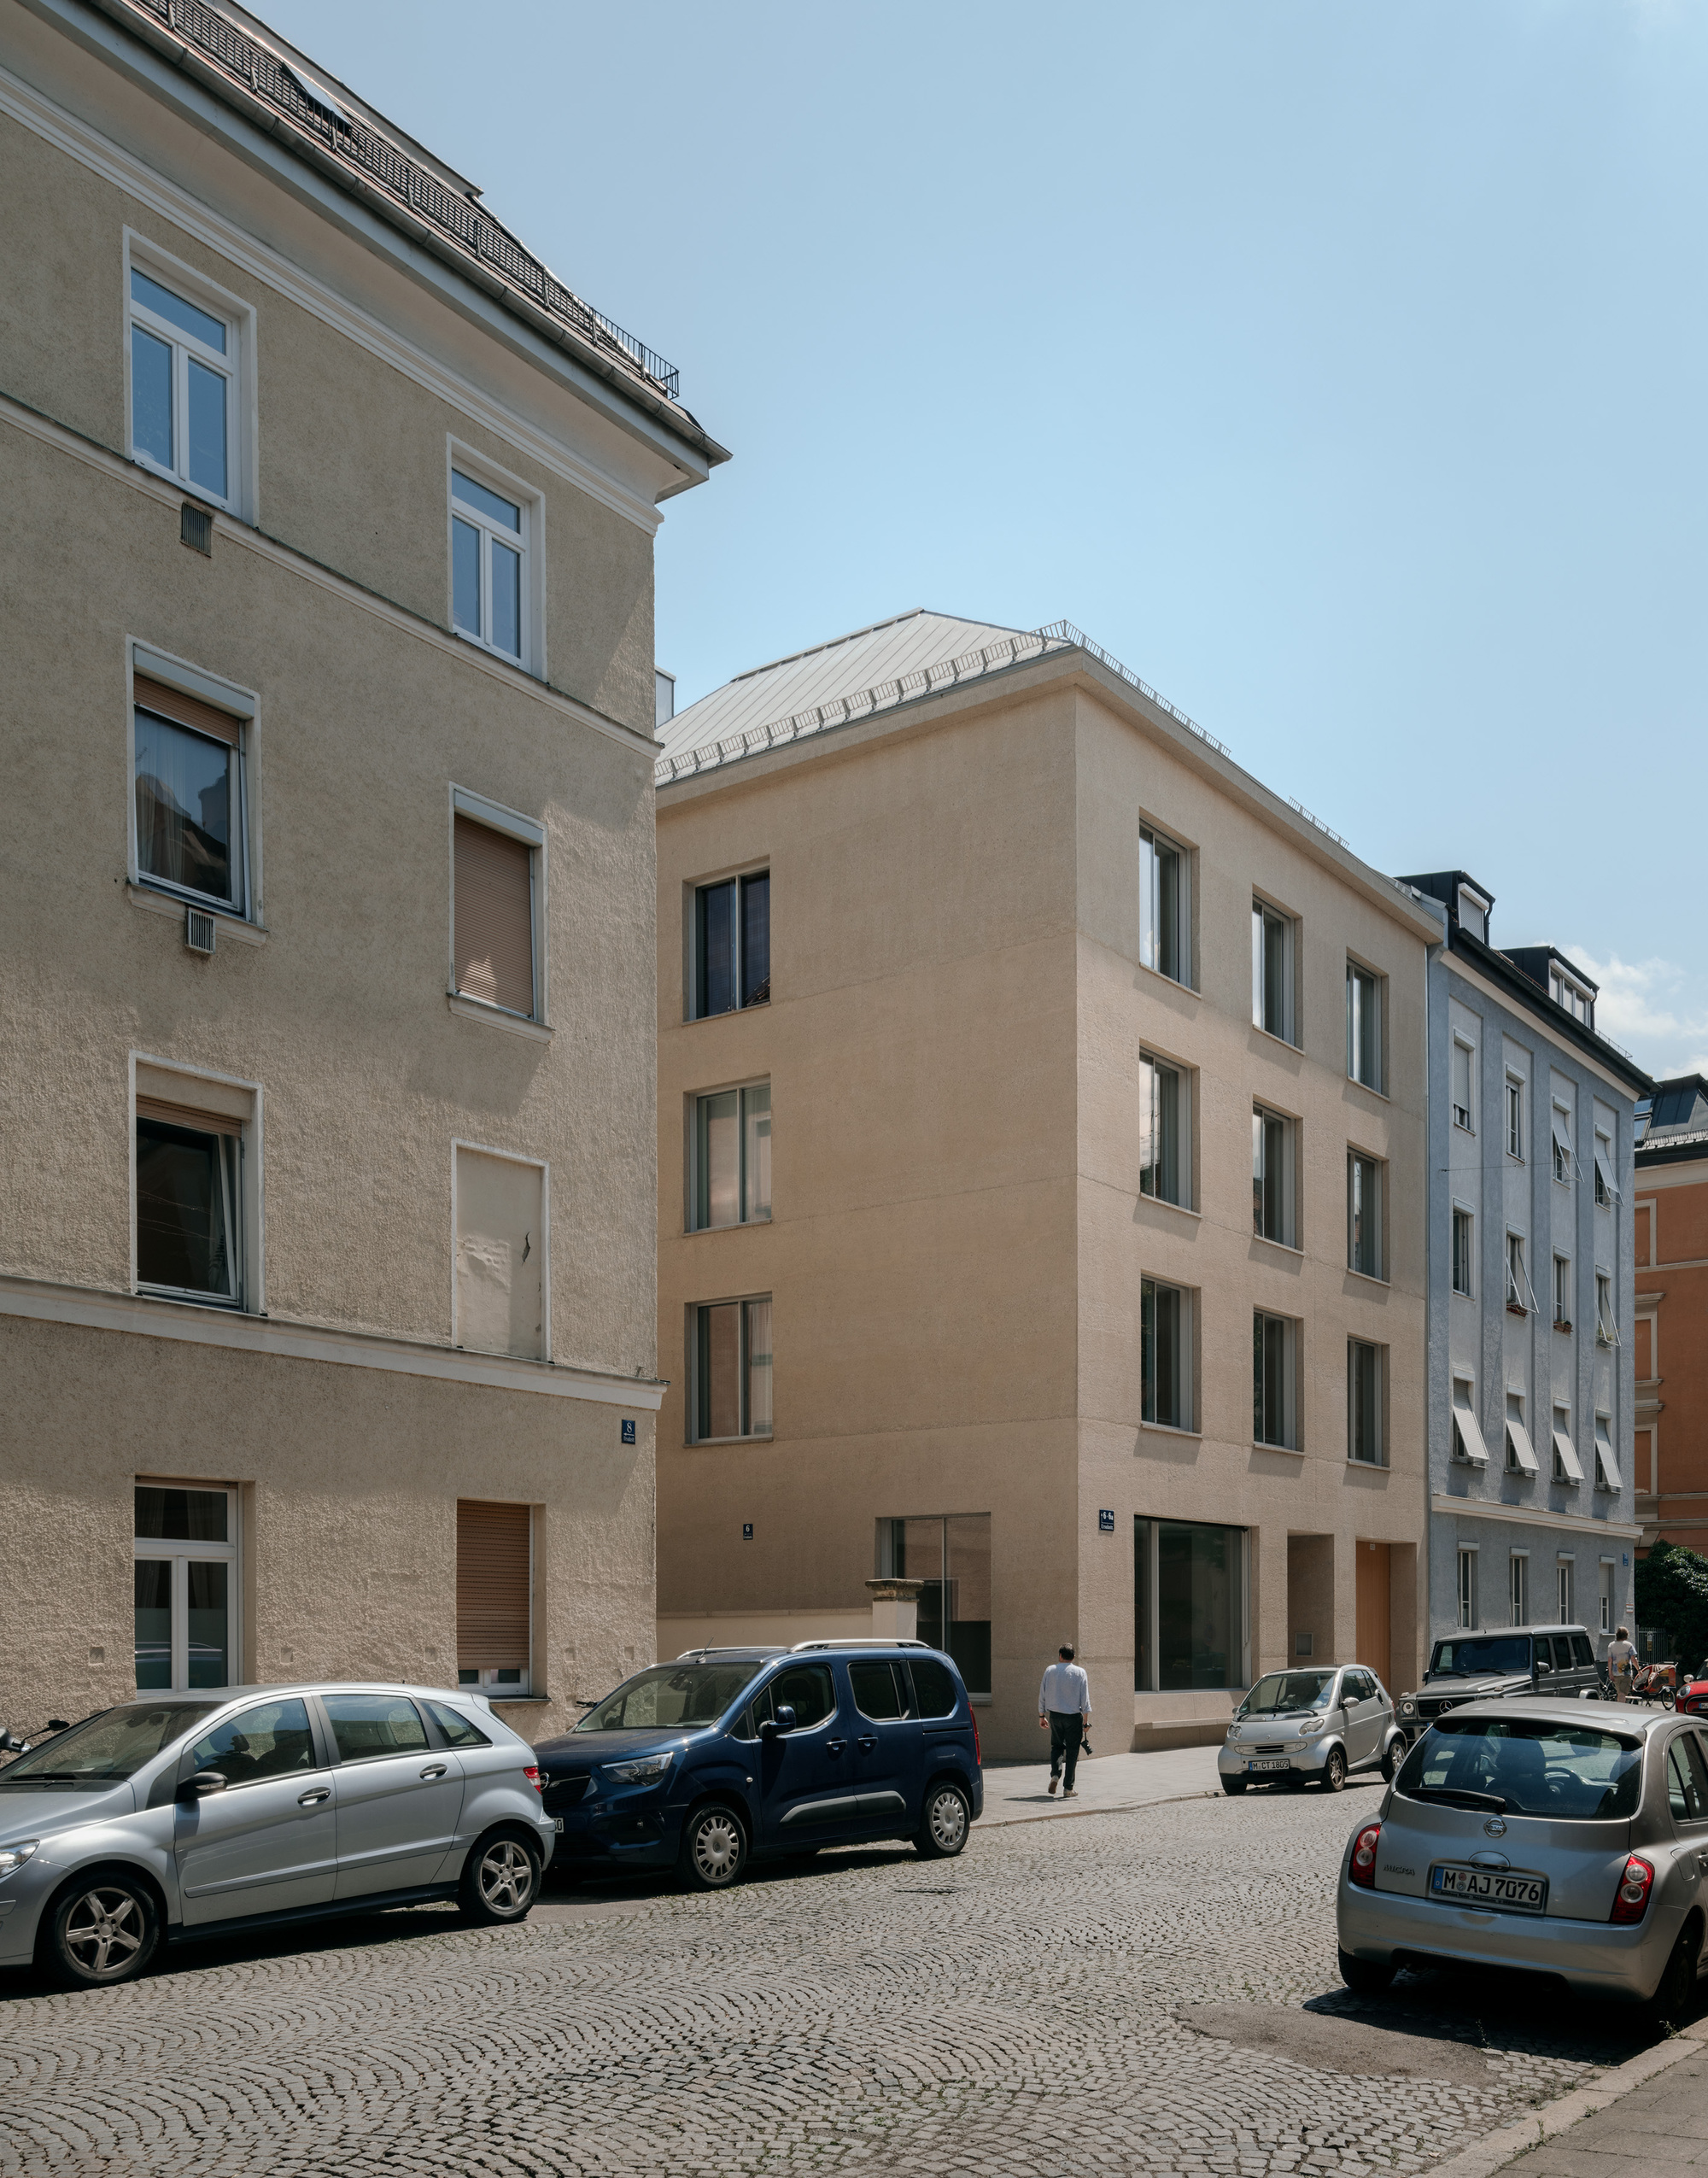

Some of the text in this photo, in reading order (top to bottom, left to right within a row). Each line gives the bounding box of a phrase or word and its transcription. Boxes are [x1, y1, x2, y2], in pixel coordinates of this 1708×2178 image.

[626, 1421, 633, 1433] 8
[1383, 1864, 1416, 1876] MICRA
[1443, 1871, 1457, 1889] M
[1466, 1875, 1491, 1894] AJ
[1494, 1878, 1540, 1901] 7076
